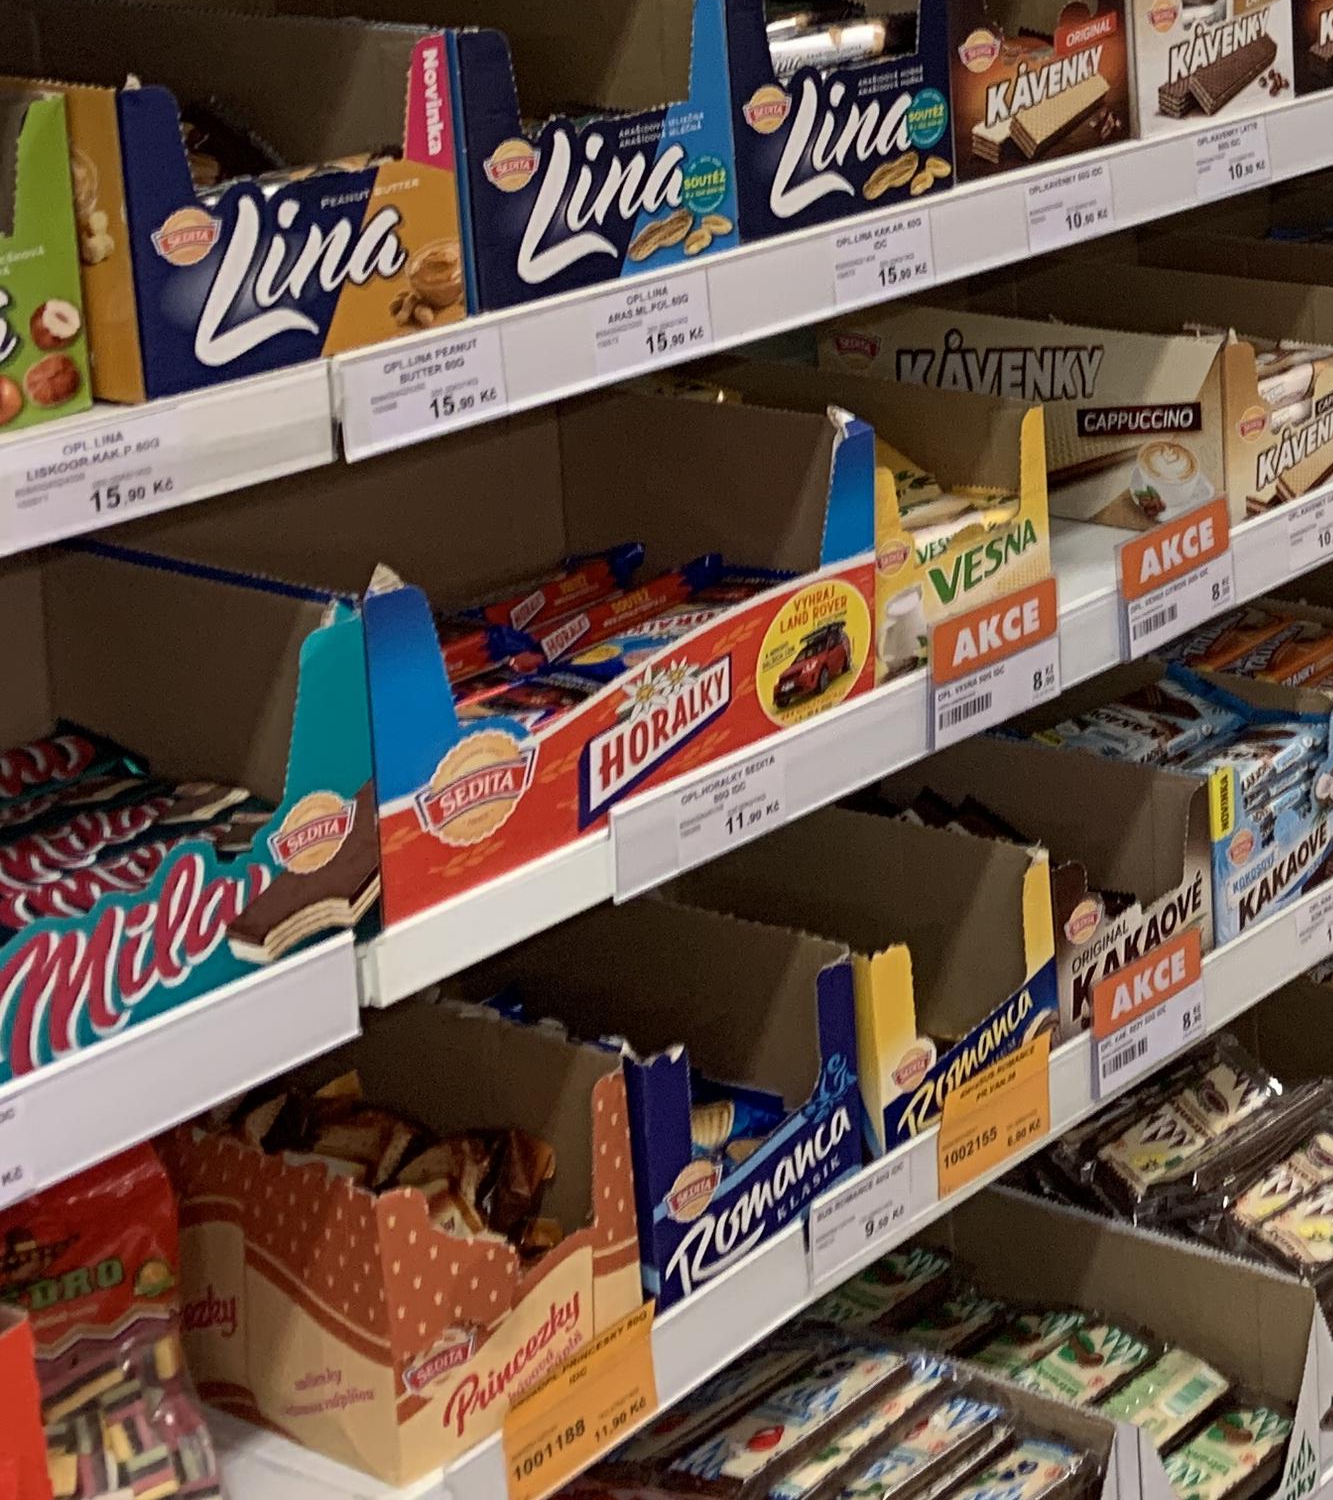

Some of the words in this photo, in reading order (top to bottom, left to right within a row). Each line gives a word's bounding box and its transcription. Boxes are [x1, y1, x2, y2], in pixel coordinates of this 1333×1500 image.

[1065, 16, 1113, 47] ORIGINAL
[421, 46, 443, 158] Novinka
[907, 104, 945, 122] SOUTĚŽ
[684, 171, 727, 192] SOUTĚŽ
[770, 75, 913, 219] Lina
[320, 188, 371, 211] PEANUT
[372, 177, 421, 200] BUTTER
[516, 128, 687, 286] Lina
[193, 193, 407, 369] Lina
[1083, 406, 1194, 433] CAPPUCCINO
[927, 518, 1039, 608] VESNA
[1138, 516, 1217, 585] AKCE
[779, 609, 809, 635] LAND
[811, 595, 849, 621] ROVER
[792, 584, 837, 614] VYHRAJ
[951, 597, 1041, 670] AKCE
[599, 660, 729, 793] HORALKY
[434, 770, 518, 824] SEDITA
[285, 816, 342, 855] SEDITA
[1237, 816, 1331, 932] KAKAOVÉ
[1071, 918, 1130, 974] ORIGINAL
[1111, 951, 1188, 1022] AKCE
[943, 1124, 999, 1172] 1002155
[665, 1103, 853, 1300] Romanca
[775, 1154, 841, 1224] KLASIK
[415, 1350, 465, 1386] SEDITA
[512, 1417, 588, 1483] 1001188
[629, 1396, 648, 1419] Kč
